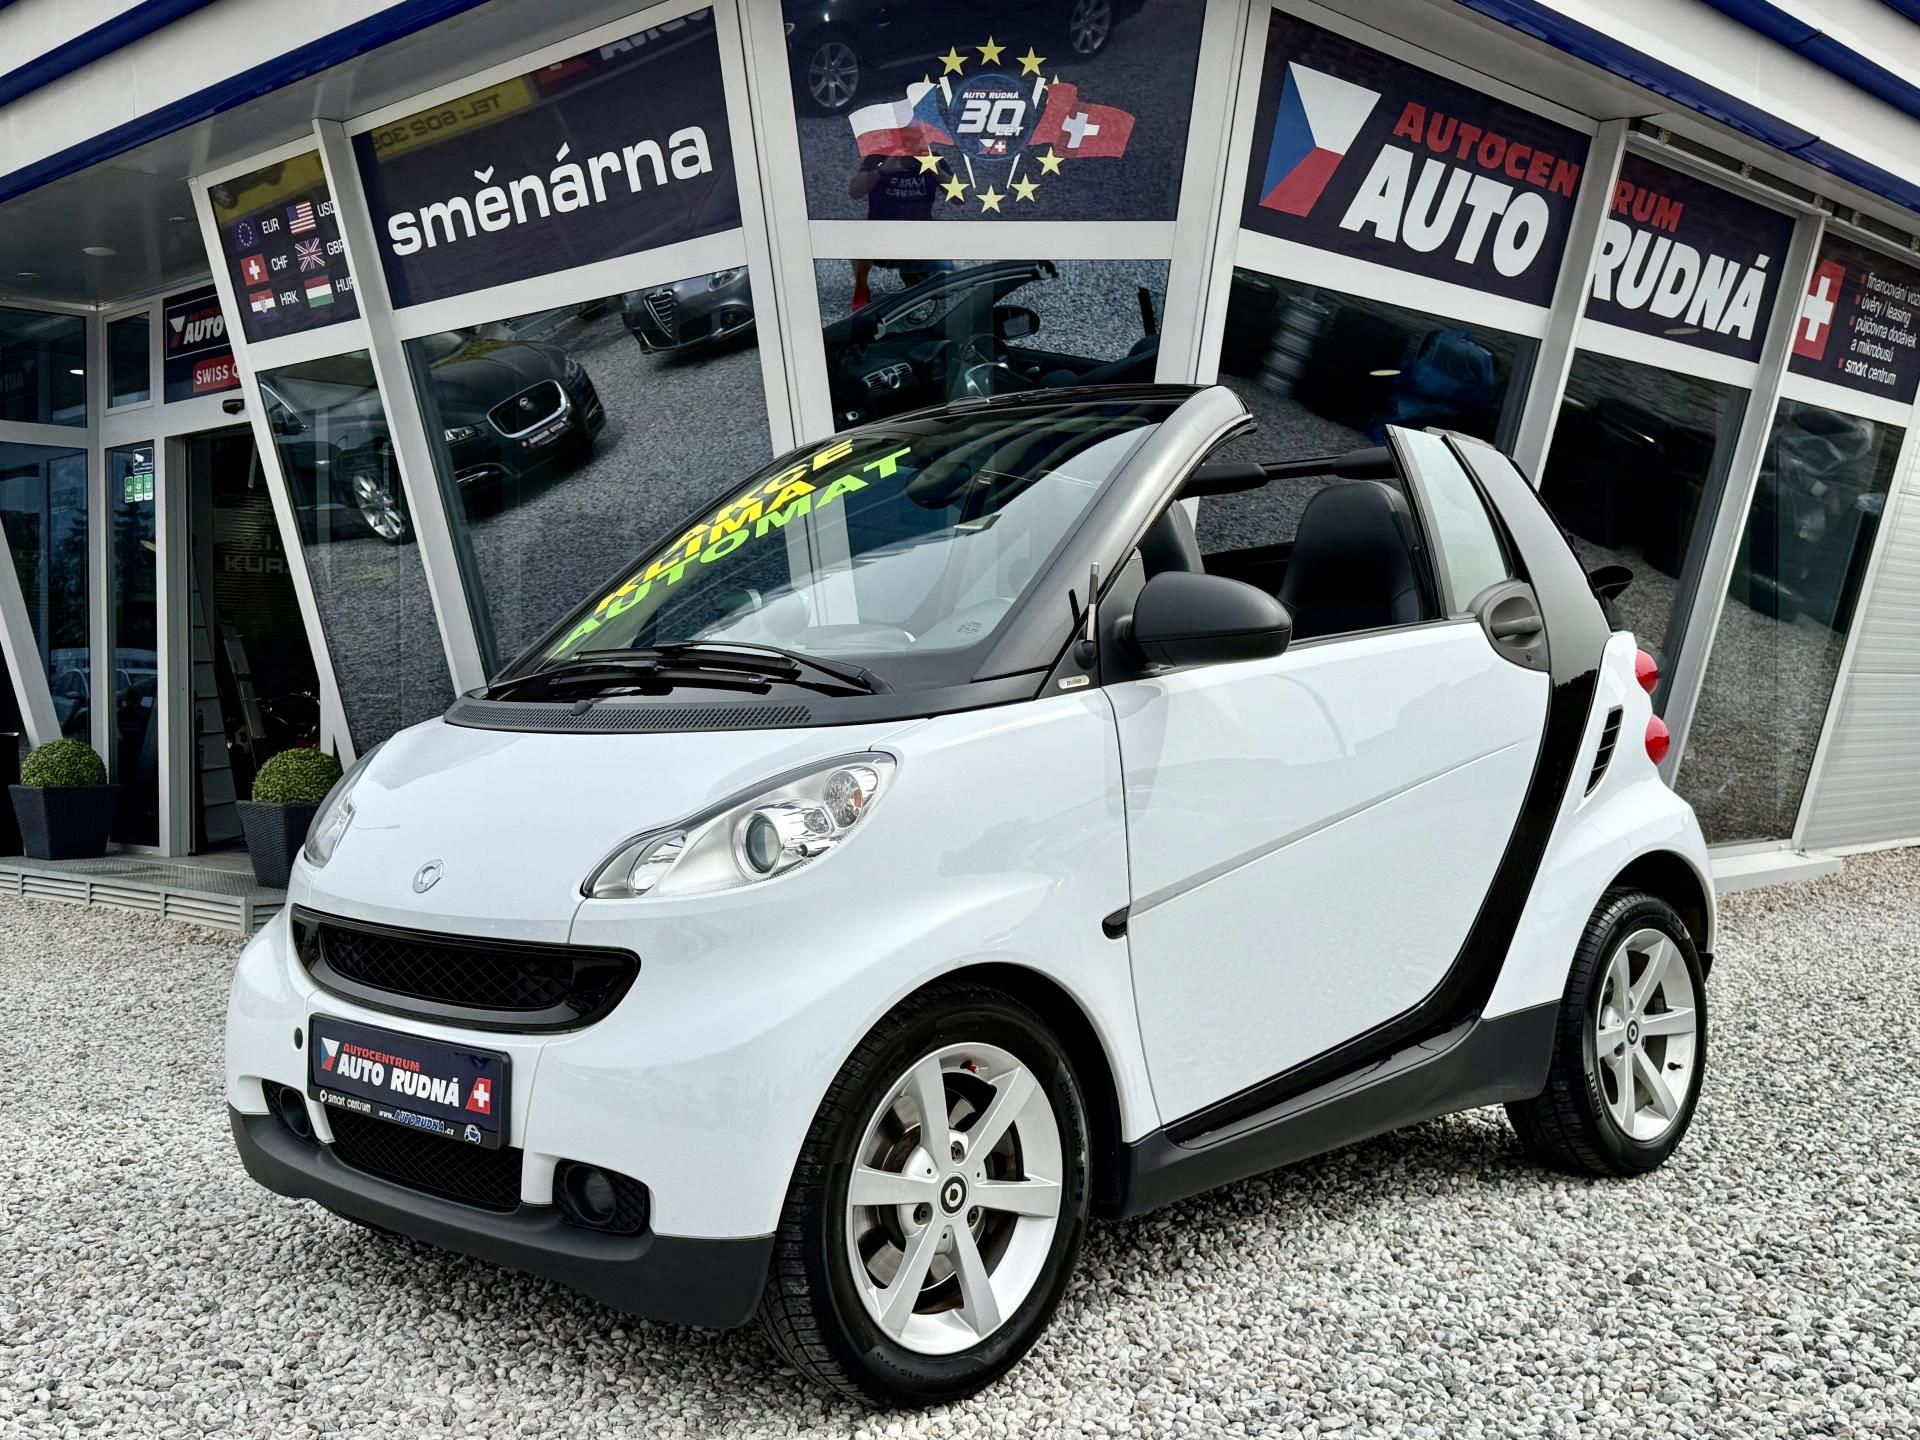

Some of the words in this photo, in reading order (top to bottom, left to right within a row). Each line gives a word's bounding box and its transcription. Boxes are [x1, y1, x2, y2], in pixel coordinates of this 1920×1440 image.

[962, 91, 986, 99] AUTO
[957, 100, 1026, 133] 30
[387, 126, 713, 256] směnárna
[261, 218, 280, 234] EUR
[1338, 143, 1549, 277] AUTO
[1592, 218, 1770, 340] RUDNÁ
[271, 255, 288, 271] CHF
[280, 289, 299, 306] HRK
[1867, 271, 1909, 300] financování
[1861, 293, 1882, 318] úvěry
[1886, 301, 1911, 328] leasing
[183, 315, 224, 345] AUTO
[1850, 338, 1856, 351] a
[1855, 316, 1888, 339] půjčovna
[1888, 326, 1918, 349] dodávek
[196, 364, 229, 385] SWISS
[1844, 359, 1868, 377] smart
[1868, 366, 1896, 385] centrum
[549, 446, 911, 660] AUTOMAT
[594, 480, 817, 615] KLIMA
[343, 1043, 420, 1072] AUTOCENTRUM
[337, 1053, 385, 1086] AUTO
[390, 1067, 460, 1108] RUDNÁ
[328, 1093, 345, 1106] smart
[347, 1099, 371, 1114] centrum
